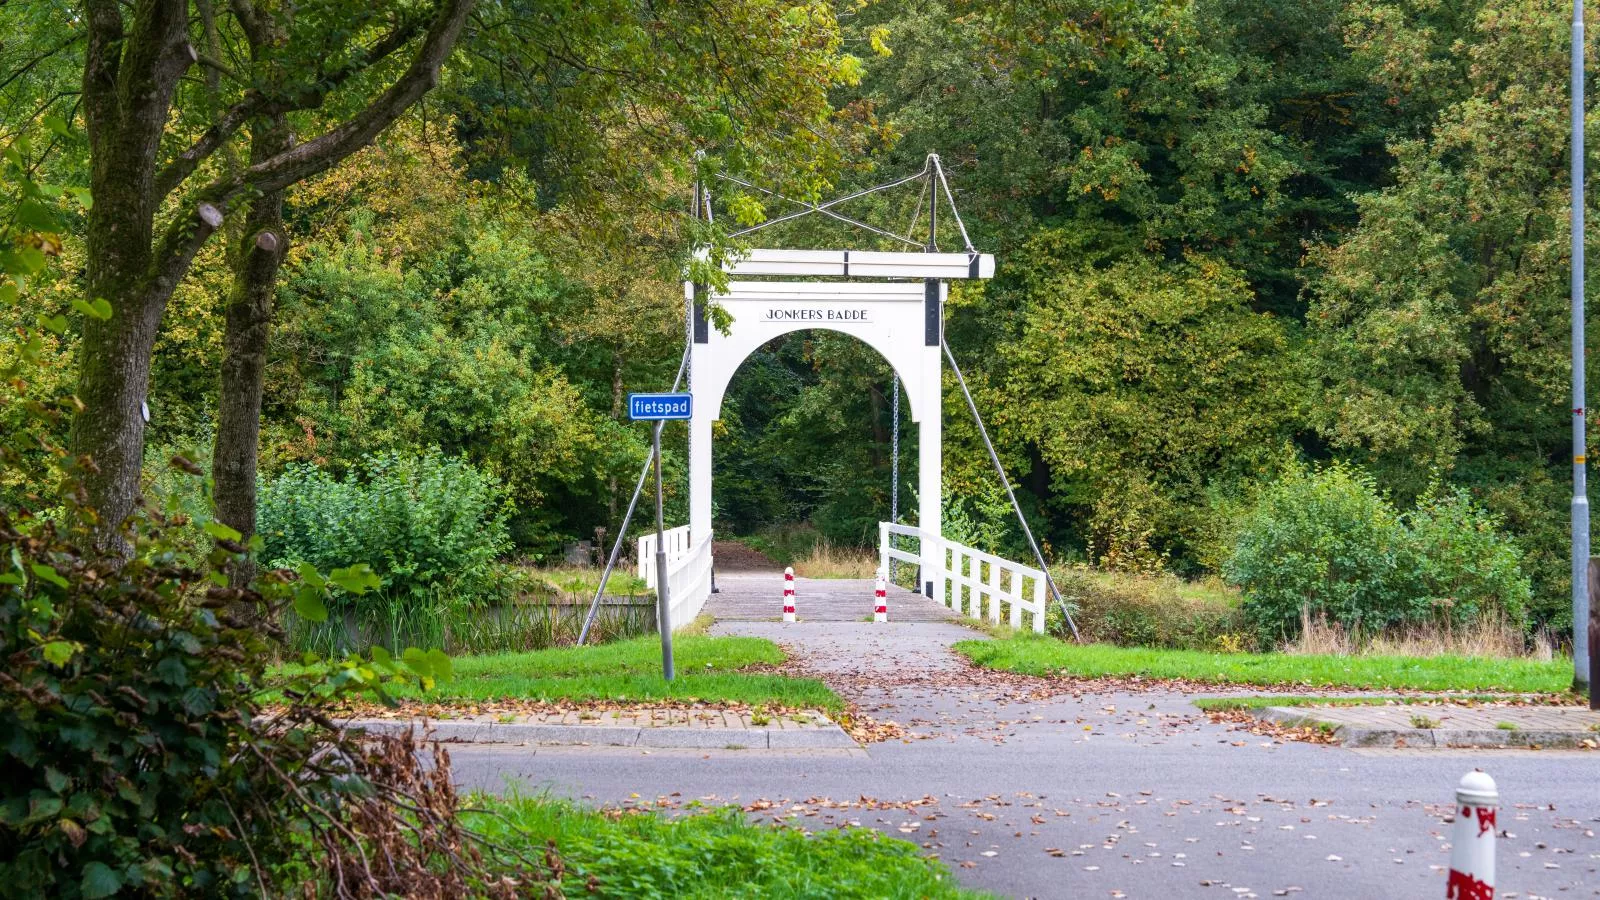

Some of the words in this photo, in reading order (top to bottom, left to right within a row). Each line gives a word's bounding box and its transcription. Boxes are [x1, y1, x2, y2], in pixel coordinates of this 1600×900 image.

[766, 309, 823, 320] JONKERS
[827, 309, 868, 320] BADDE
[635, 400, 687, 415] fietspad
